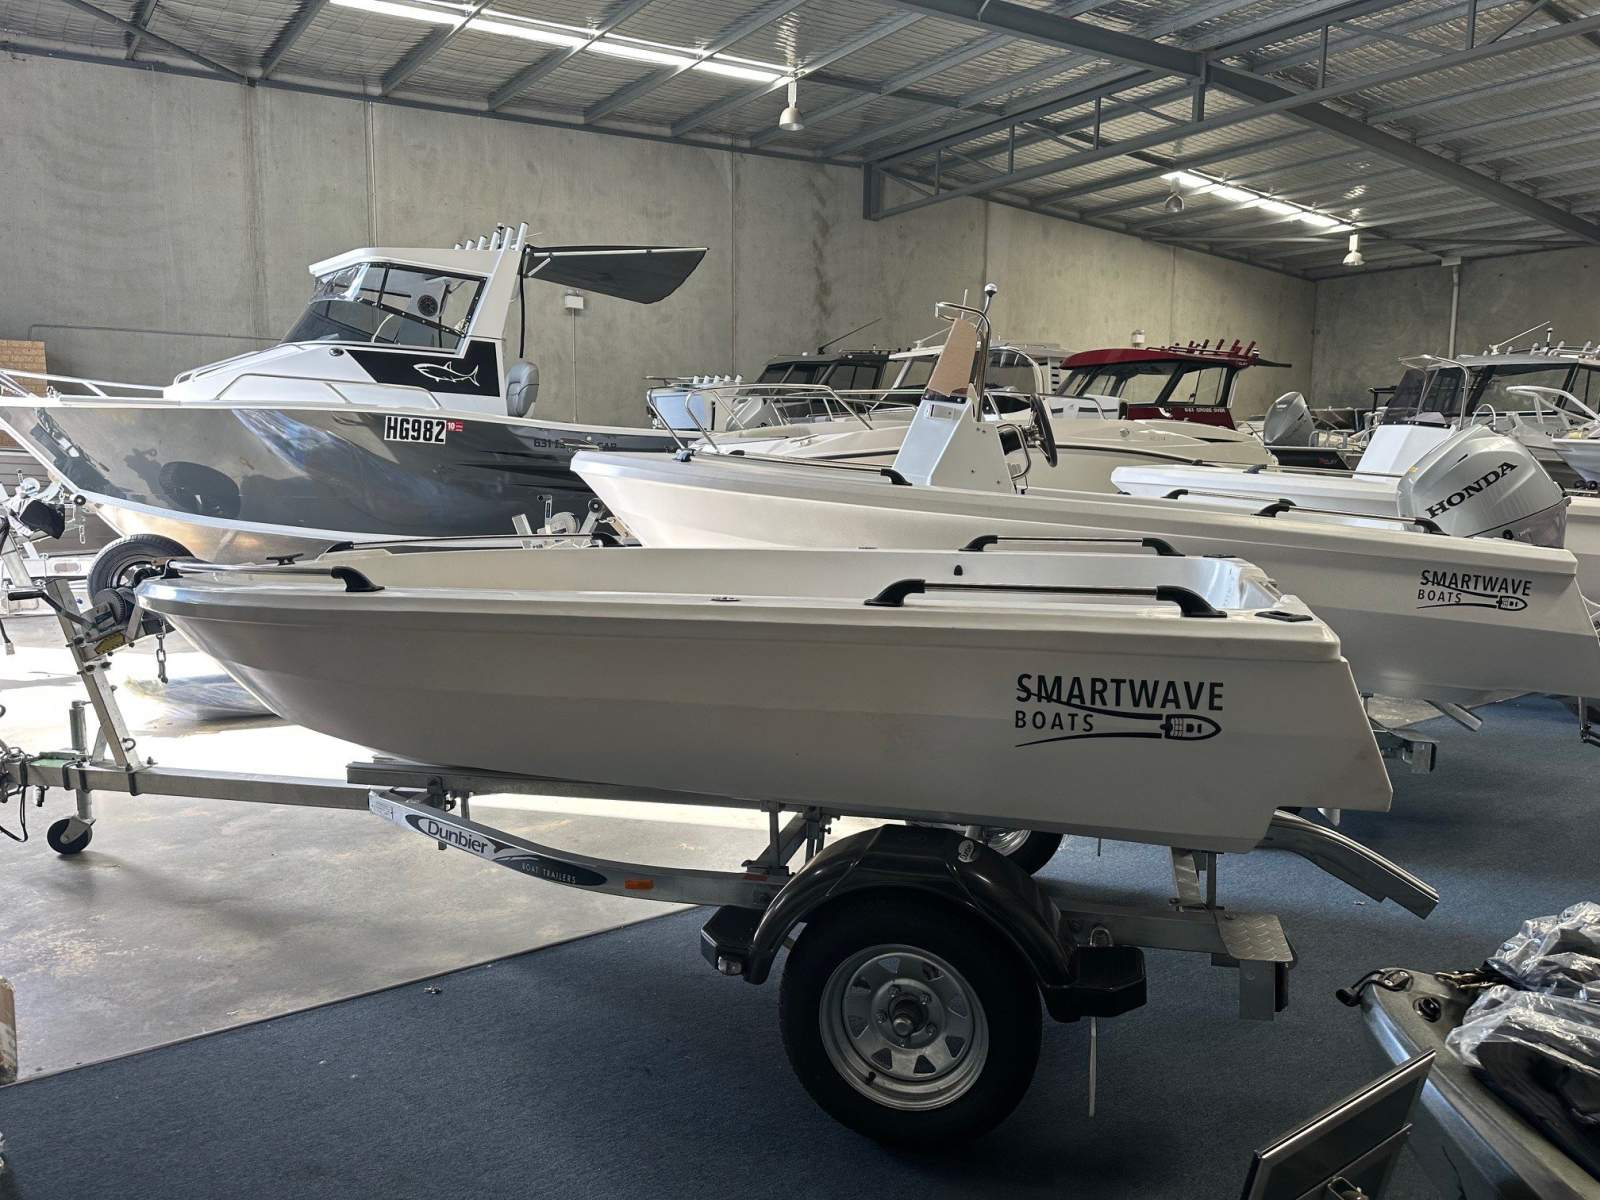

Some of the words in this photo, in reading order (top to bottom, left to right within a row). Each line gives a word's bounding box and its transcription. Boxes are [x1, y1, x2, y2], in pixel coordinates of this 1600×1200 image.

[386, 416, 446, 442] HG982
[1425, 462, 1518, 518] HONDA
[1420, 569, 1532, 596] SMARTWAVE
[1417, 588, 1462, 604] BOATS
[1016, 673, 1224, 712] SMARTWAVE
[1015, 710, 1094, 732] BOATS
[427, 820, 489, 854] Dunbier
[521, 862, 539, 874] BOAT
[542, 868, 577, 884] TRAILERS
